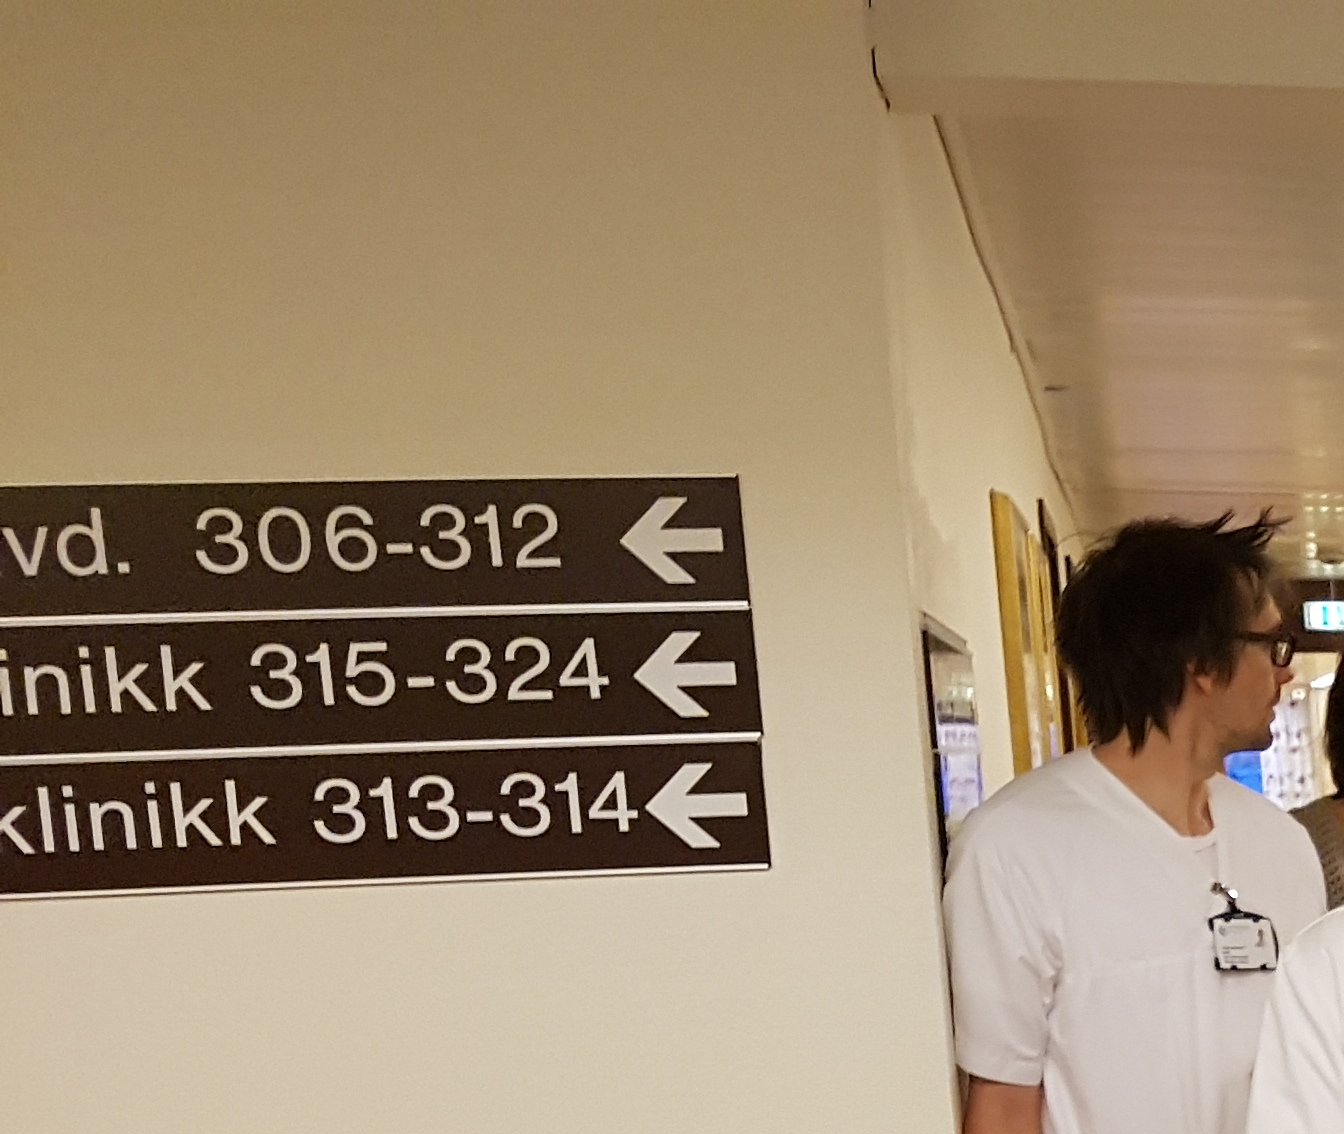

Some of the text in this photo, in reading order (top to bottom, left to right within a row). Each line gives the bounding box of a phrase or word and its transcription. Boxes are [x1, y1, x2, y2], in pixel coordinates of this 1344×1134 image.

[1, 503, 562, 577] vd. 306-312
[0, 636, 610, 716] inikk 315-324
[313, 770, 639, 844] 313-314
